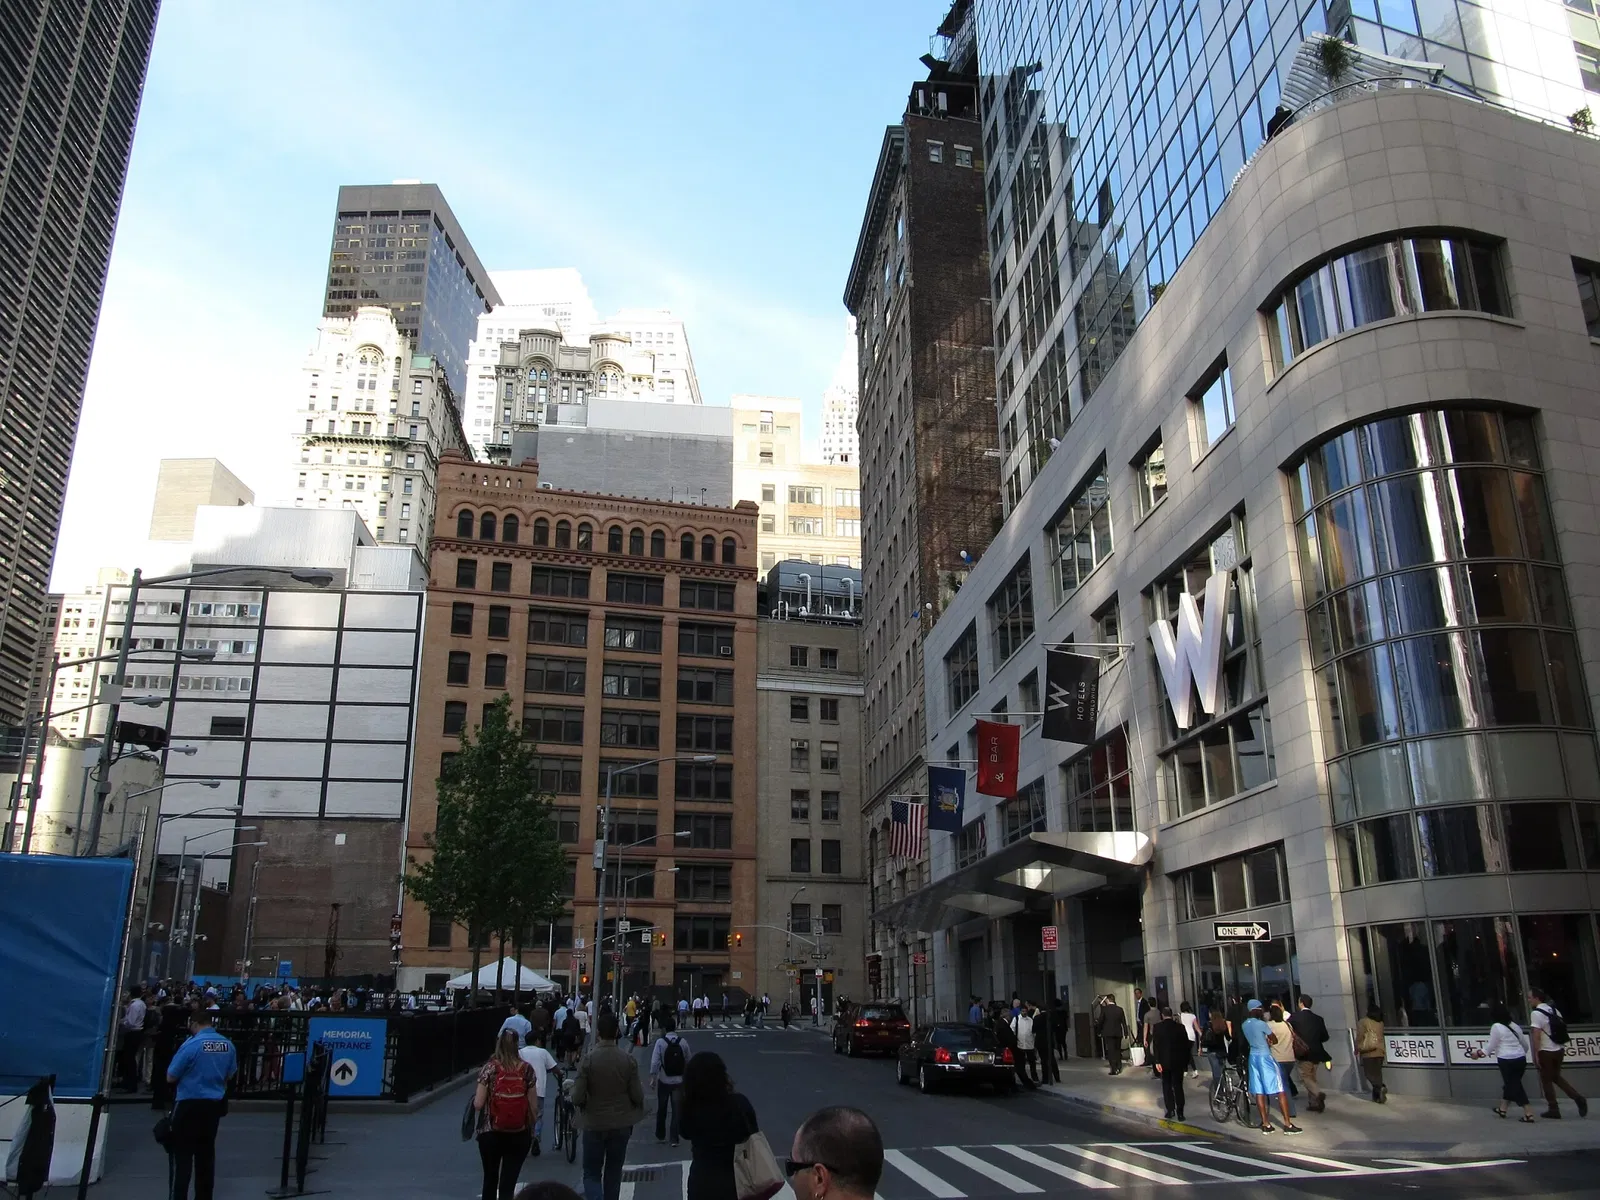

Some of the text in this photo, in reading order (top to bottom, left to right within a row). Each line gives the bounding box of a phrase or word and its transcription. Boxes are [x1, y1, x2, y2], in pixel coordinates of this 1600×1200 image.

[1149, 571, 1232, 729] W
[1047, 680, 1070, 712] W
[1076, 681, 1086, 721] HOTELS
[990, 736, 1004, 783] & BAR
[1221, 927, 1261, 936] ONE WAY
[323, 1030, 372, 1039] MEMORIAL
[203, 1042, 228, 1052] SECURITY
[323, 1041, 372, 1050] ENTRANCE
